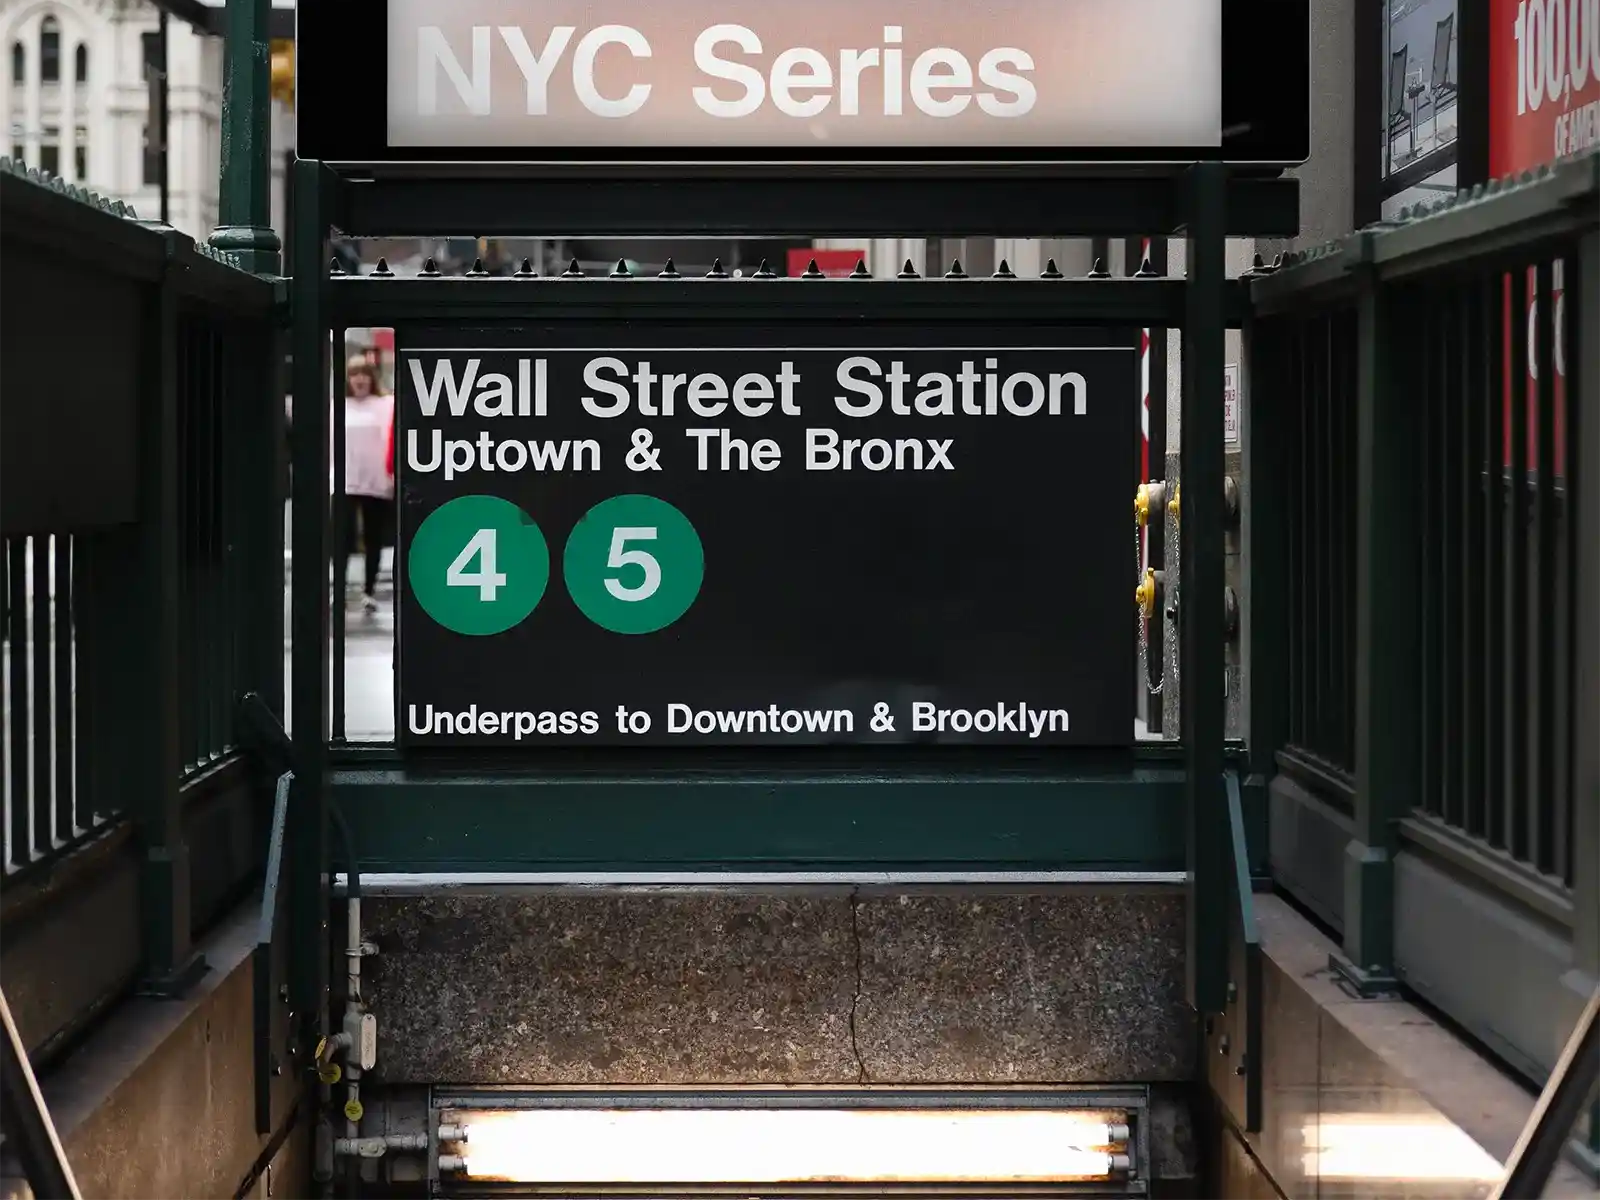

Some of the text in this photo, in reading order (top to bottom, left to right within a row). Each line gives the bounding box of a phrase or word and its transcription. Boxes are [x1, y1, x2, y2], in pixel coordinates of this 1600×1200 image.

[417, 24, 1037, 117] NYC Series
[408, 356, 1087, 418] Wall Street Station
[407, 427, 955, 481] Uptown & The Bronx
[446, 527, 662, 602] 4 5
[408, 701, 1069, 741] Underpass to Downtown & Brooklyn
